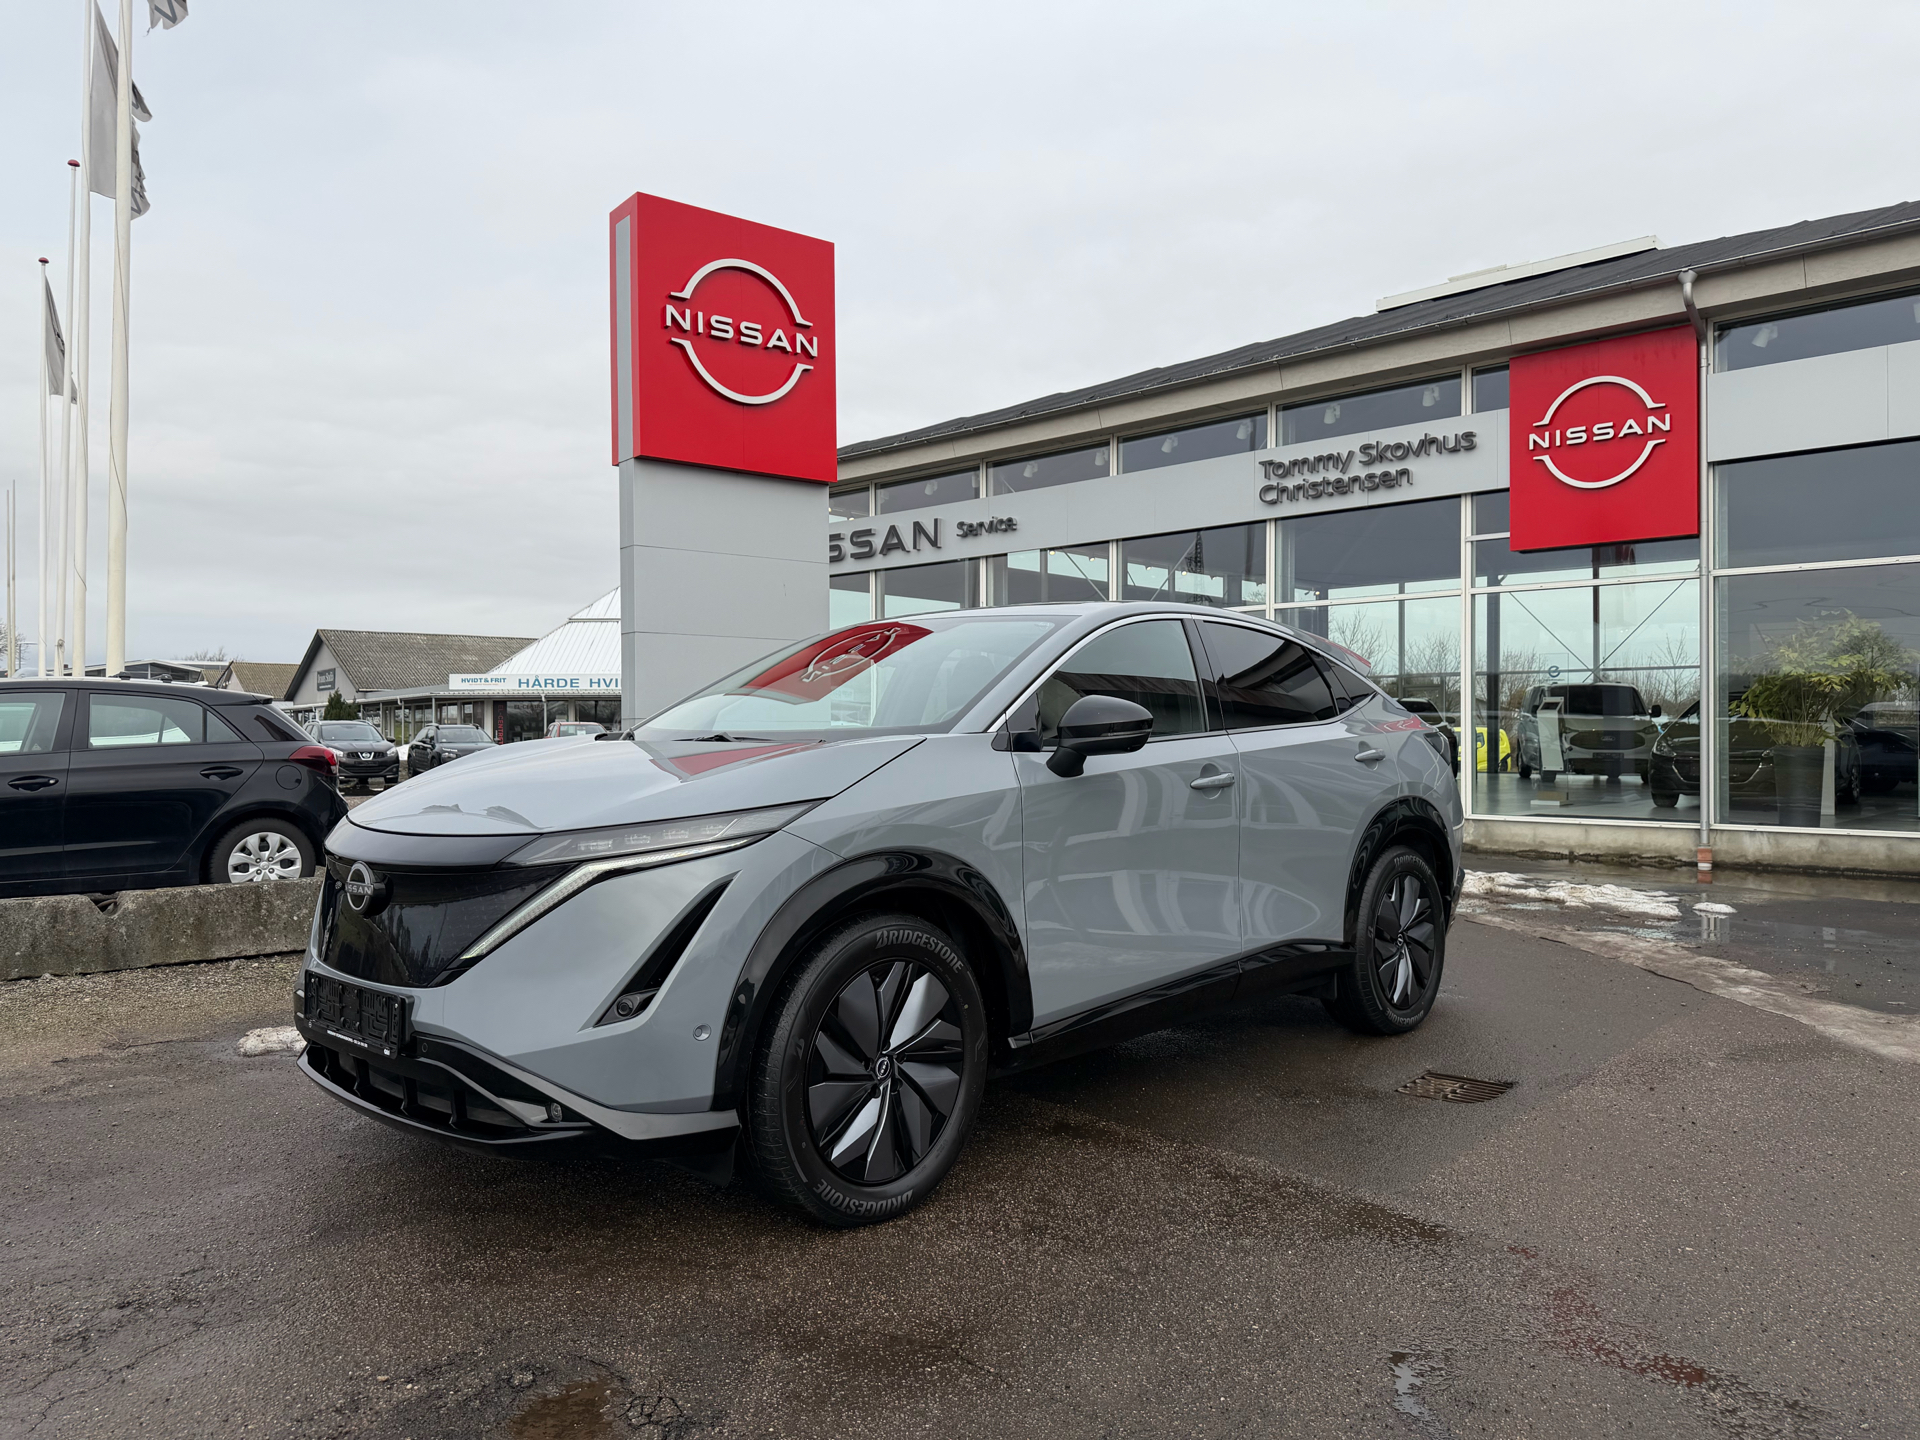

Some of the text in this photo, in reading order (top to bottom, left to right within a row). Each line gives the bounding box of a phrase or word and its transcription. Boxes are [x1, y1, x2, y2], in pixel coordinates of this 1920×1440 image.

[665, 304, 818, 358] NISSAN
[1528, 413, 1671, 450] NISSAN
[1259, 431, 1477, 480] Tommy Skovhus
[1259, 467, 1413, 505] Christensen
[956, 515, 1018, 538] Service
[518, 675, 580, 688] HÅRDE
[875, 929, 964, 974] BRIDGESTONE
[813, 1178, 914, 1217] BRIDGESTONE
